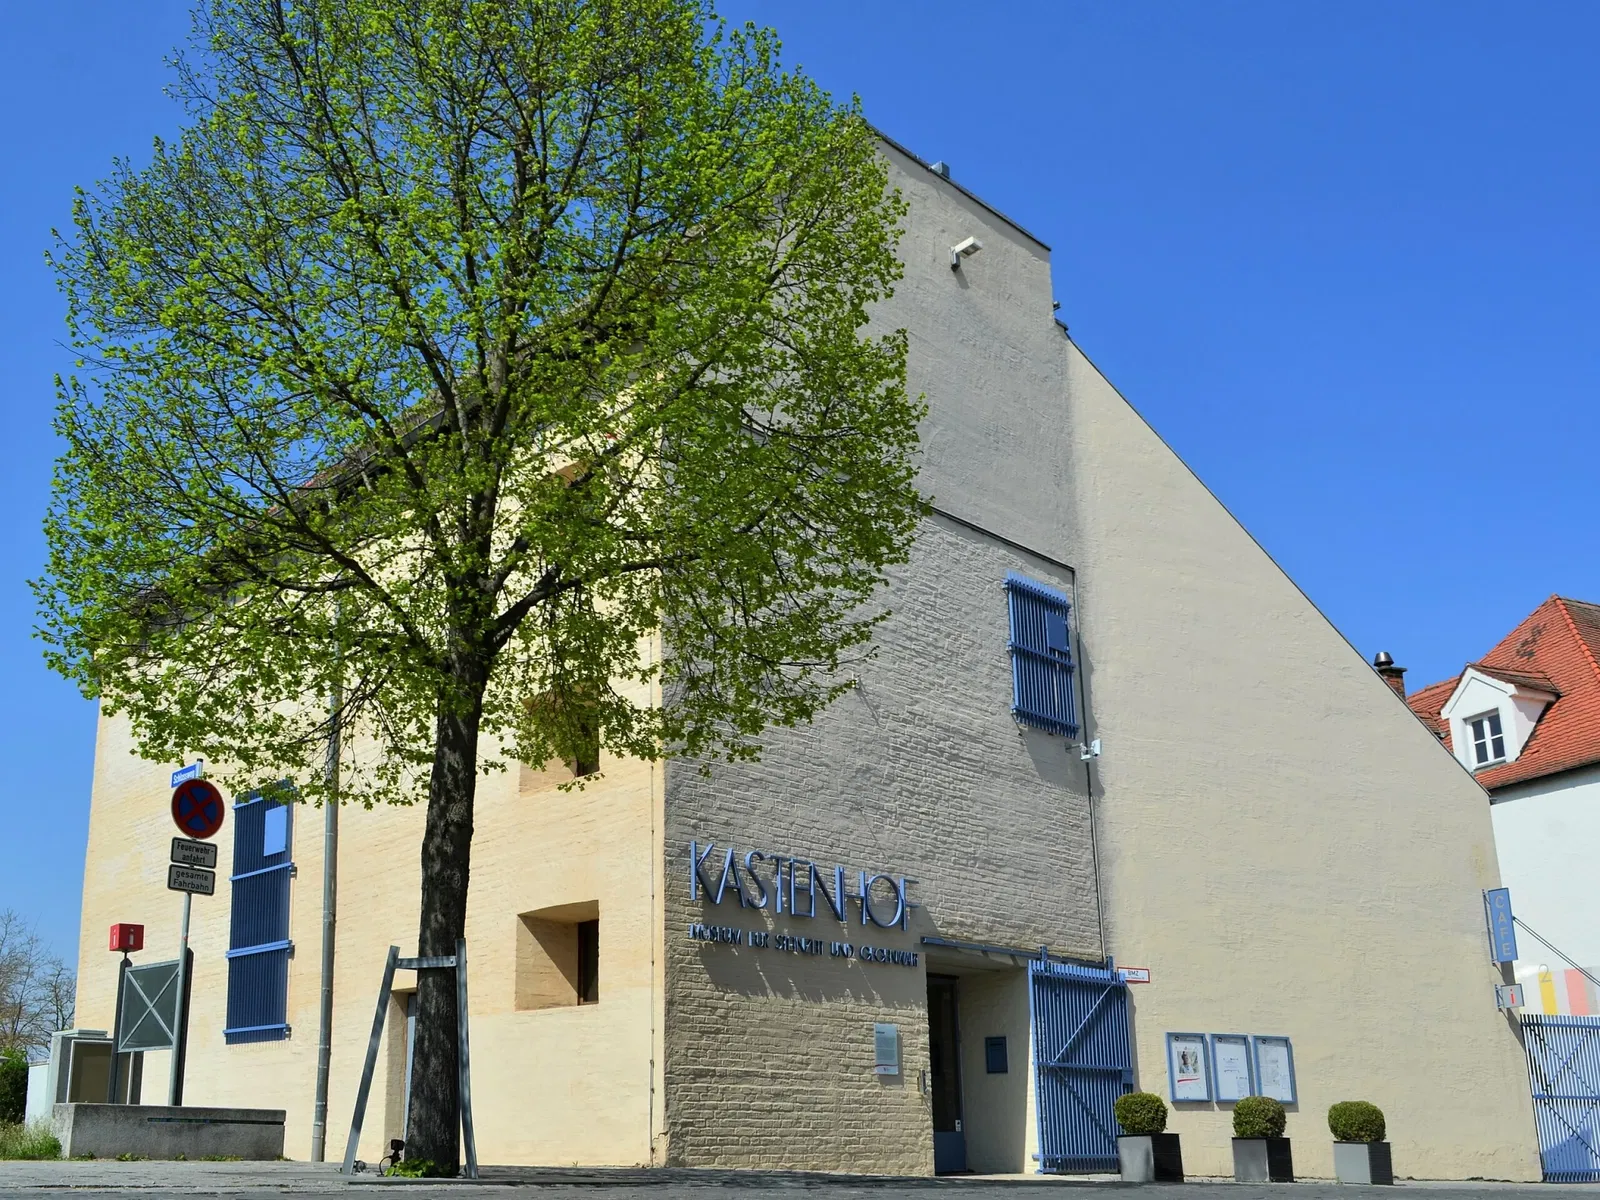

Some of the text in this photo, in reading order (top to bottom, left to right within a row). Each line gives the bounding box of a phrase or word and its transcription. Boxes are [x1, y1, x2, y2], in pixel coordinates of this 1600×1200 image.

[177, 841, 214, 855] Feuerwehr-
[182, 853, 206, 864] anfahrt
[175, 870, 209, 881] gesamte
[173, 878, 210, 891] Fahrbahn
[690, 840, 919, 931] KASTENHOF
[689, 922, 742, 946] MUSEUM
[831, 941, 856, 958] UND
[860, 944, 919, 968] GEGENWART
